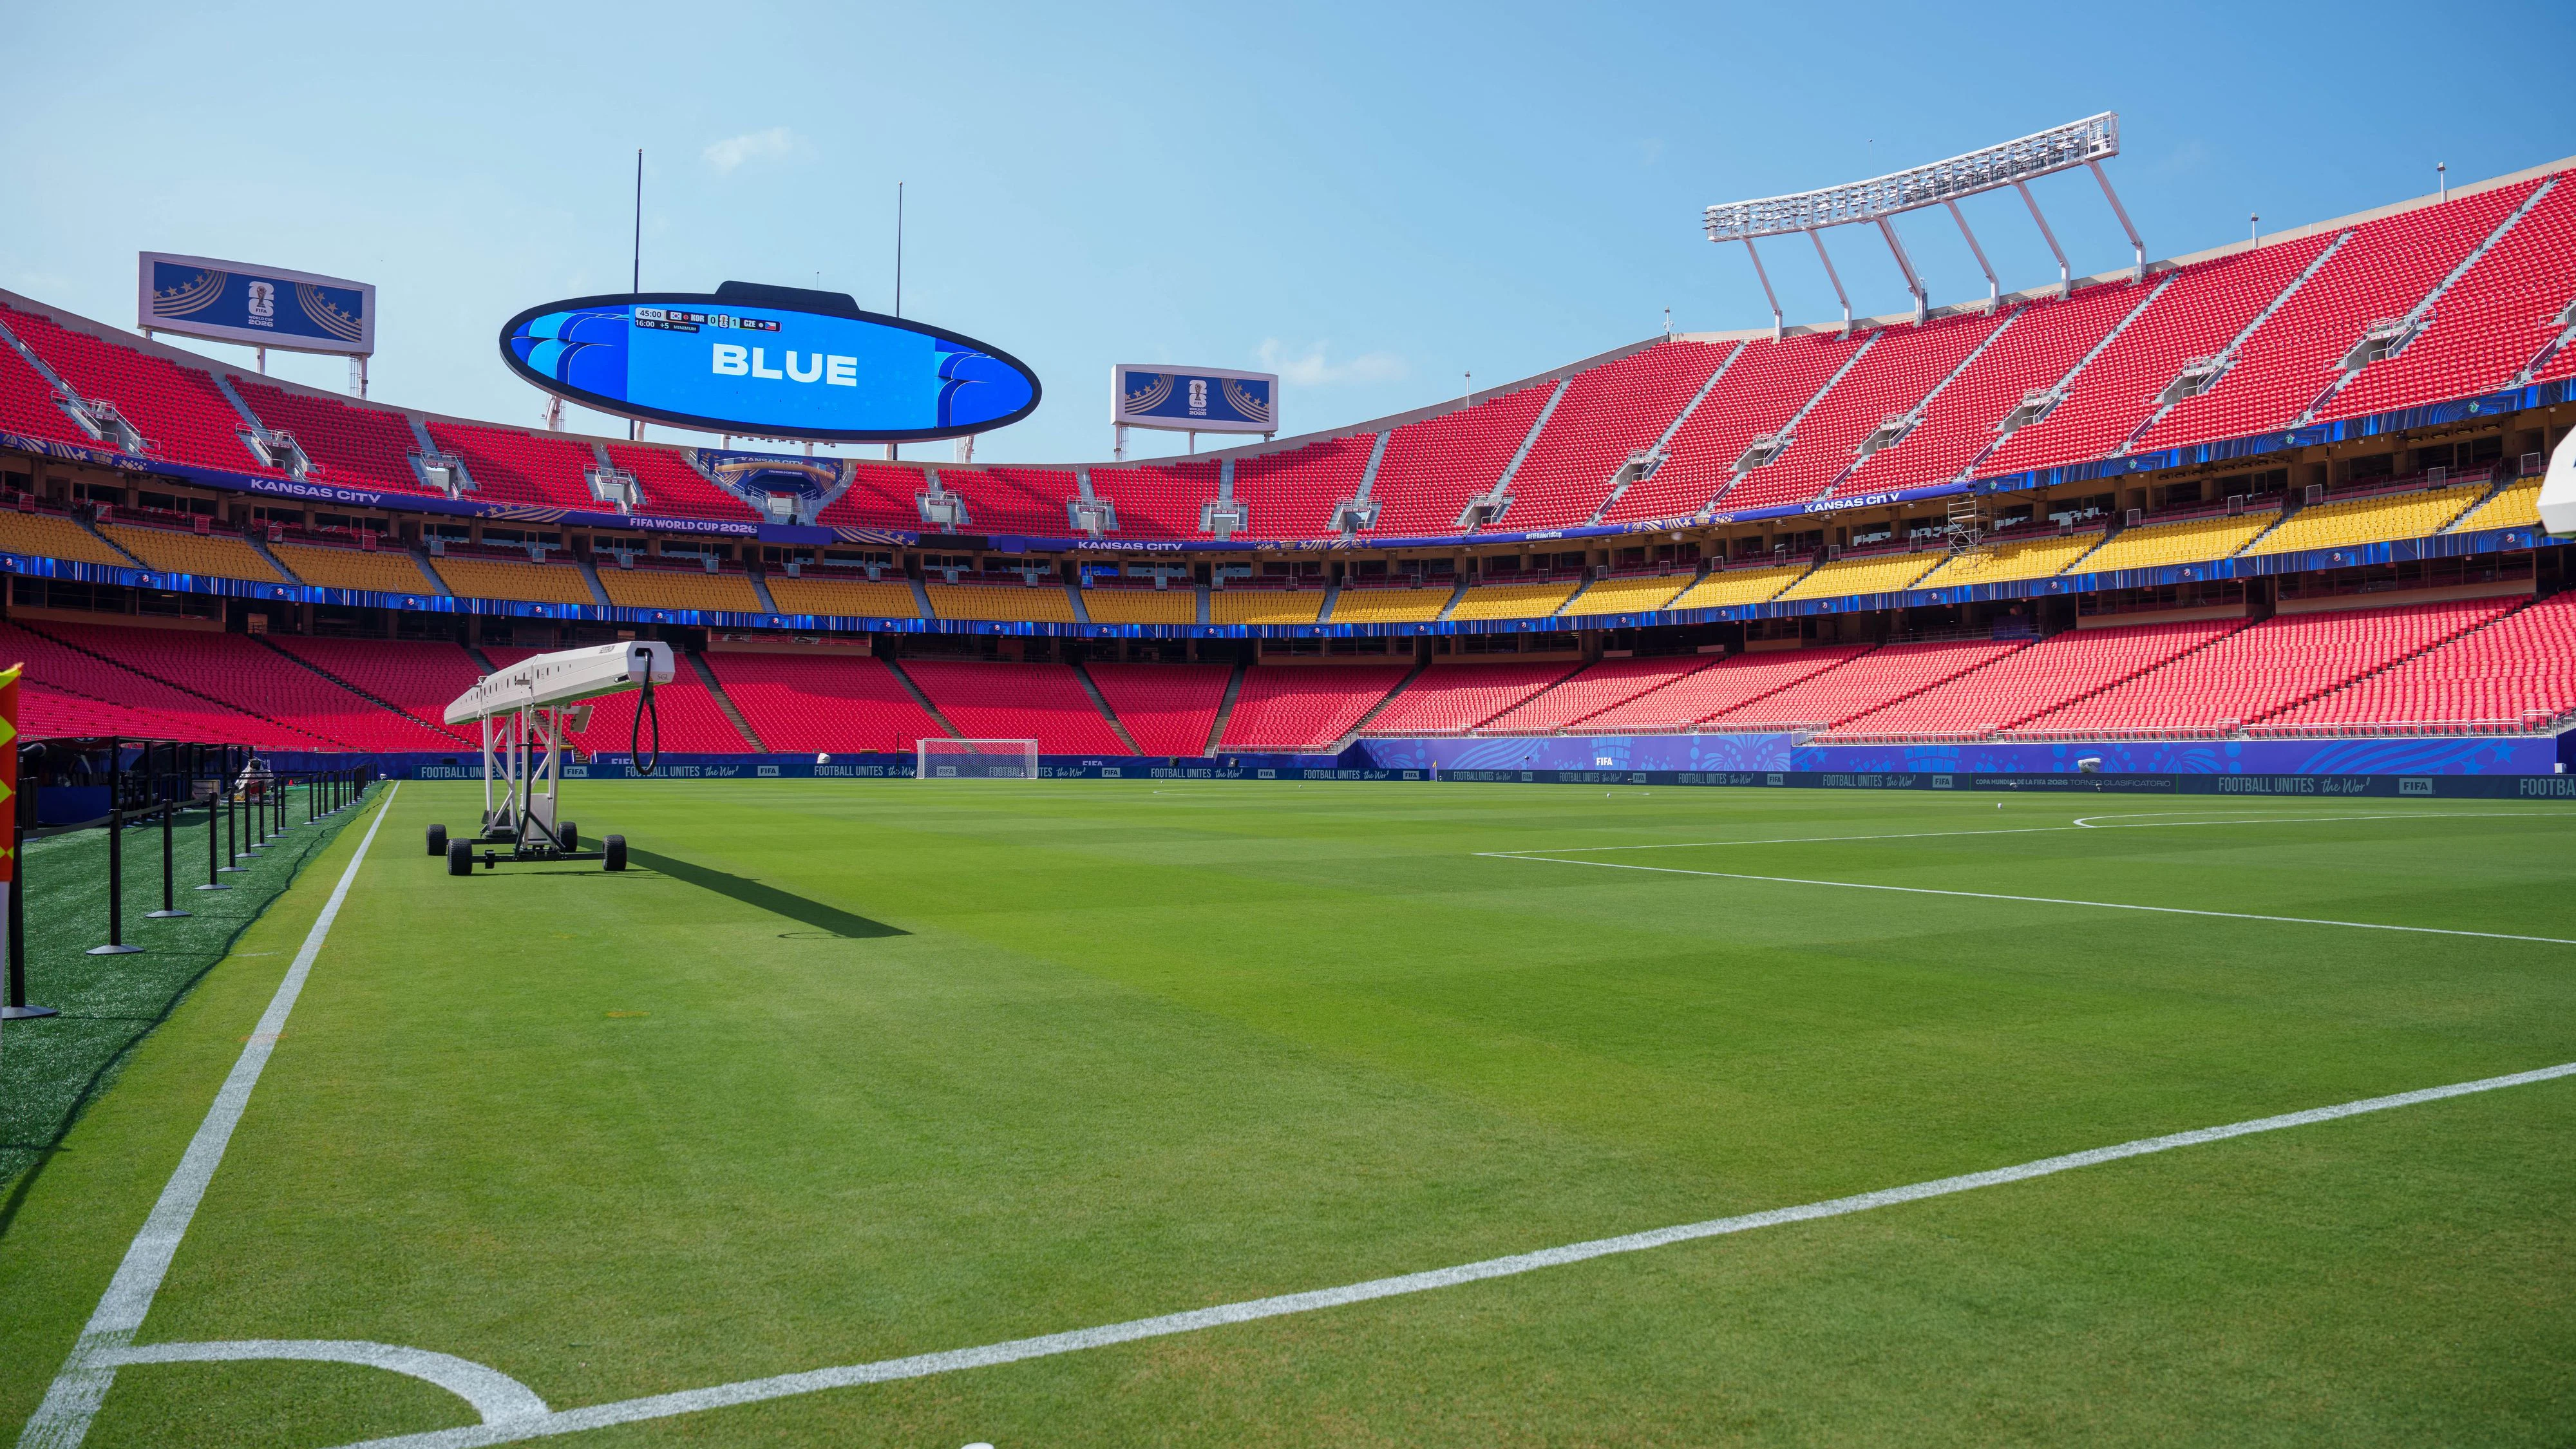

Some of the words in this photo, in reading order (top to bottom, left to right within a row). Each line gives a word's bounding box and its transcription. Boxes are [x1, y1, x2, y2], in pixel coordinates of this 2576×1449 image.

[639, 310, 661, 318] 45:00
[690, 314, 705, 323] KOR
[248, 319, 274, 328] 2026
[636, 319, 655, 328] 16:00
[712, 343, 857, 386] BLUE
[251, 479, 333, 498] KANSAS
[337, 491, 381, 503] CITY
[1804, 497, 1864, 513] KANSAS
[1866, 492, 1900, 505] CITY
[630, 518, 654, 527] FIFA
[655, 520, 696, 530] WORLD
[697, 522, 719, 531] CUP
[720, 524, 758, 534] 2026
[1526, 531, 1562, 540] #FIFAWorldCup
[1078, 542, 1144, 550] KANSAS
[1596, 757, 1613, 766] FIFA
[421, 766, 467, 778] FOOTBALL
[469, 767, 500, 778] UNIES
[670, 766, 699, 777] UNITES
[705, 765, 719, 777] the
[814, 765, 853, 776] FOOTBALL
[856, 766, 883, 776] UNITES
[1056, 767, 1068, 777] the
[1151, 768, 1185, 778] FOOTBALL
[1188, 768, 1211, 778] UNITES
[1215, 768, 1227, 778] the
[1304, 770, 1336, 779] FOOTBALL
[1338, 770, 1359, 779] UNITES
[1363, 770, 1374, 779] the
[1454, 771, 1478, 781] FOOTBALL
[1479, 772, 1493, 781] UNITES
[1559, 772, 1582, 782] FOOTBALL
[1582, 772, 1599, 782] UNITES
[1602, 772, 1611, 782] the
[1678, 773, 1705, 784] FOOTBALL
[1707, 773, 1726, 784] UNITES
[1730, 773, 1739, 784] the
[1823, 774, 1855, 786] FOOTBALL
[1858, 774, 1882, 786] UNITES
[1886, 775, 1898, 787] the
[2219, 777, 2271, 792] FOOTBALL
[2275, 777, 2315, 793] UNITES
[2320, 777, 2340, 793] the
[2403, 781, 2428, 791] FIFA
